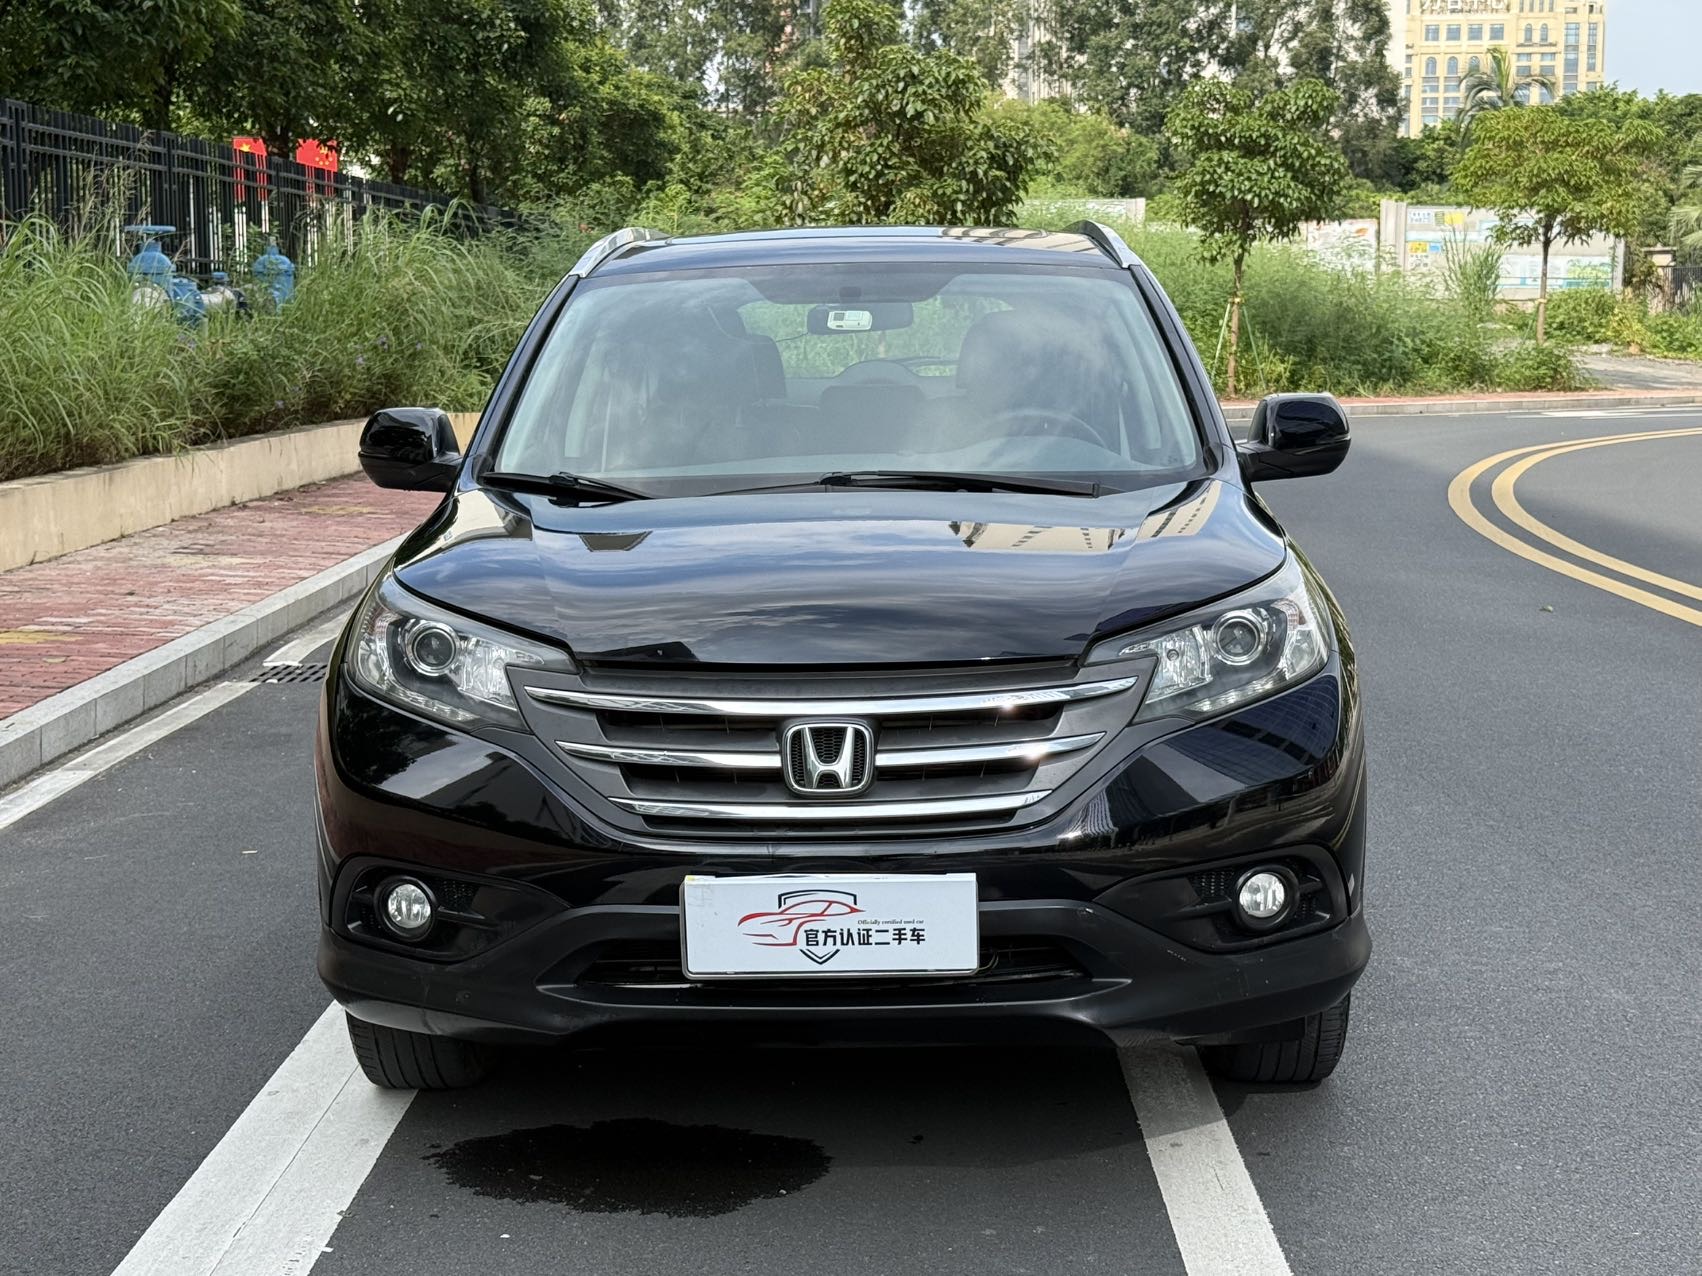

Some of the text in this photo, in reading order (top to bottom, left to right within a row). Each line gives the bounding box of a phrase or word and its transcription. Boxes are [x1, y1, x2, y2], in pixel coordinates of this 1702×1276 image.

[804, 927, 926, 946] 官方认证二手车
